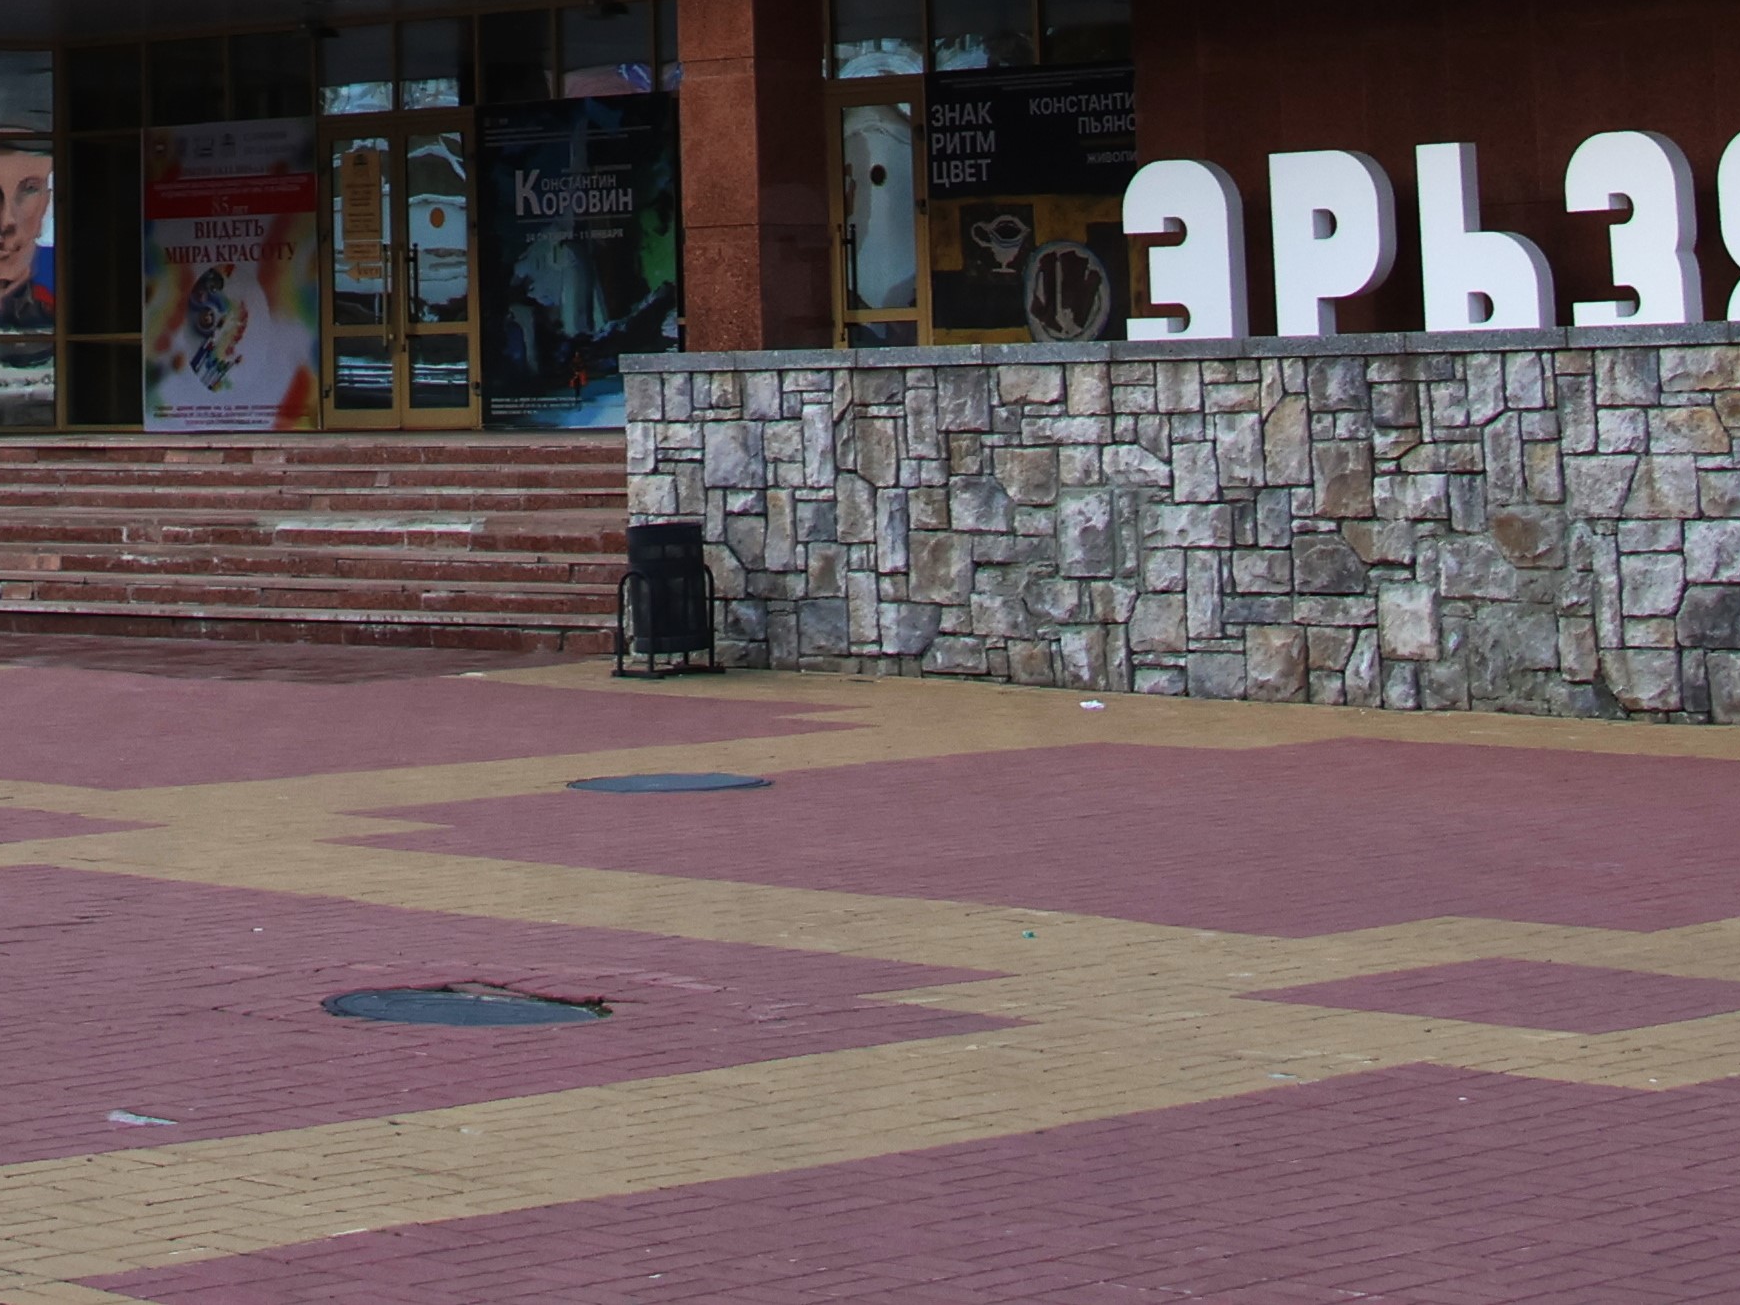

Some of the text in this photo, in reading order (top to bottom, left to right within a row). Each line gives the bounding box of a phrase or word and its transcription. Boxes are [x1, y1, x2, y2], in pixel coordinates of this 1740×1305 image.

[931, 101, 993, 127] ЗНАК
[931, 130, 996, 156] РИТМ
[932, 159, 992, 188] ЦВЕТ
[515, 169, 633, 216] КОРОВИН
[194, 218, 264, 240] ВИДЕТЬ
[164, 242, 298, 265] МИРА КРАСОТУ
